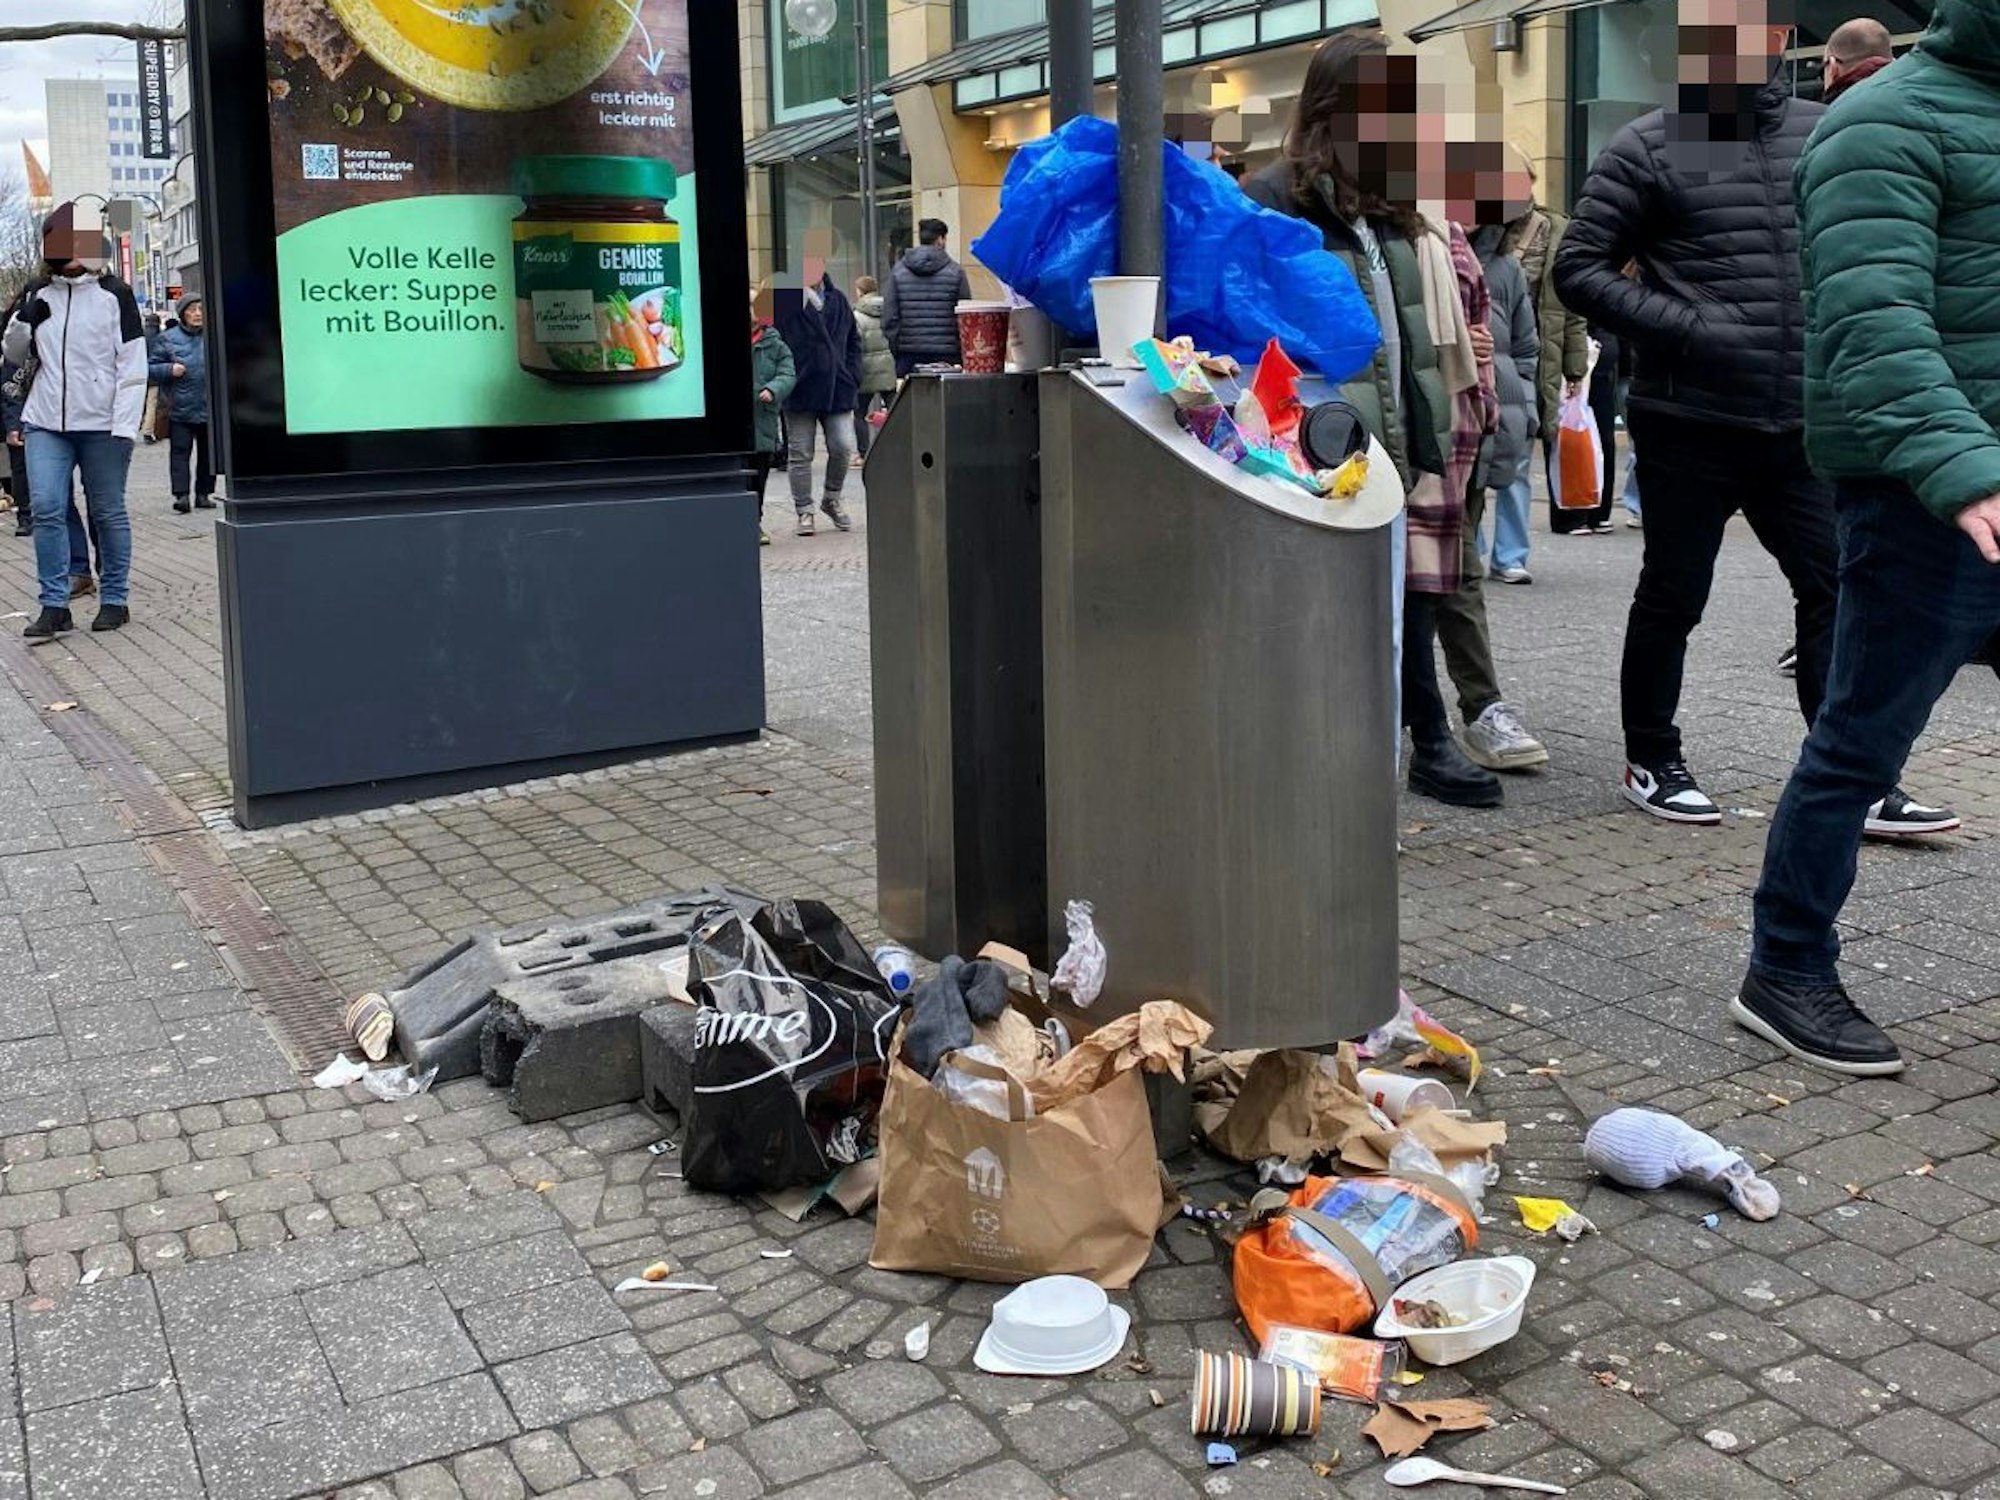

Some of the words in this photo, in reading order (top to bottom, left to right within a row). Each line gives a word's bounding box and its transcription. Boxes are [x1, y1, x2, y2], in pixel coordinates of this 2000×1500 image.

[590, 91, 621, 104] erst
[624, 90, 674, 110] richtig
[599, 111, 647, 126] lecker
[649, 113, 676, 127] mit
[344, 161, 366, 169] und
[367, 161, 414, 172] Rezepte
[344, 171, 402, 181] entdecken
[348, 246, 418, 269] Volle
[427, 247, 495, 269] Kelle
[599, 244, 664, 270] GEMÜSE
[619, 271, 665, 286] BOUILLON
[301, 278, 397, 301] lecker:
[407, 278, 497, 307] Suppe
[326, 310, 375, 333] mit
[385, 309, 505, 332] Bouillon.
